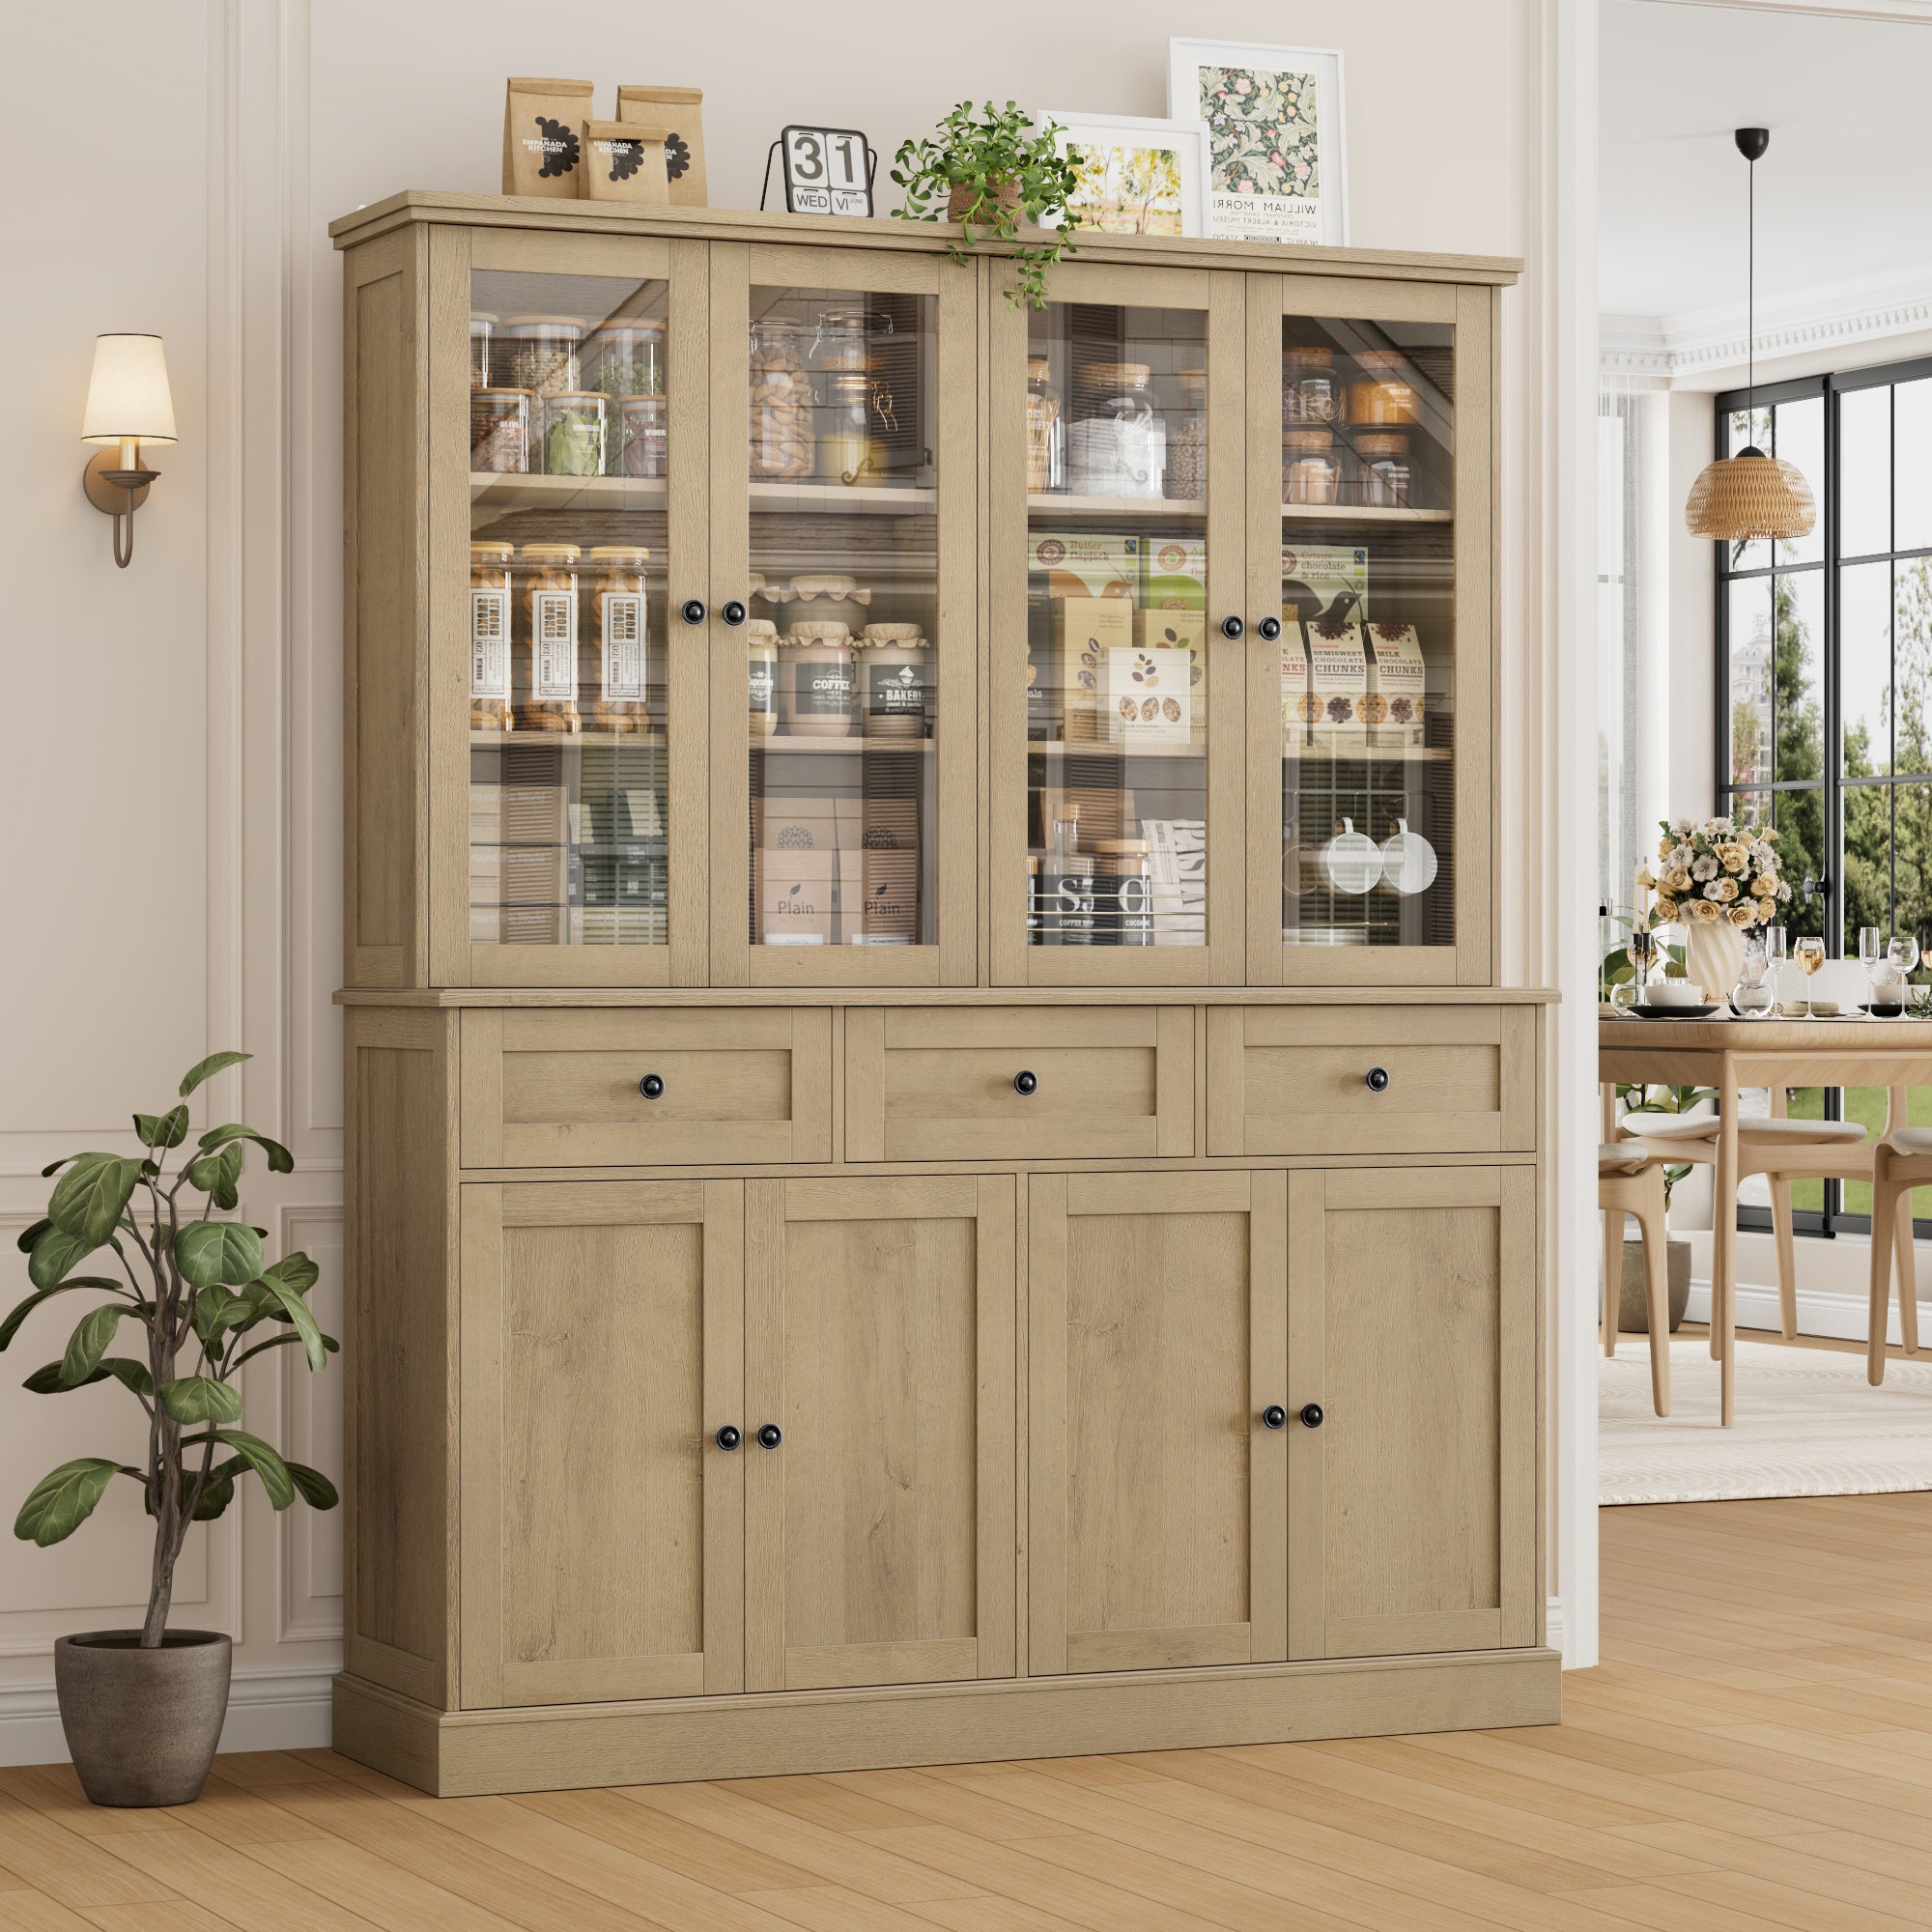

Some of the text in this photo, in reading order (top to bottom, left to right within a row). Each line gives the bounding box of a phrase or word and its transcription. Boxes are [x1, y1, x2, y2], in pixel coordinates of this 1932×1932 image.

[523, 138, 568, 148] EMPANADA
[593, 140, 633, 149] EMPANADA
[796, 194, 828, 208] WED
[836, 197, 849, 211] VI
[1070, 540, 1103, 550] Butter
[1301, 561, 1346, 570] chocolate
[1379, 666, 1423, 674] CHUNKS
[812, 679, 850, 690] COFFEE
[778, 900, 814, 915] Plain
[865, 900, 900, 916] Plain
